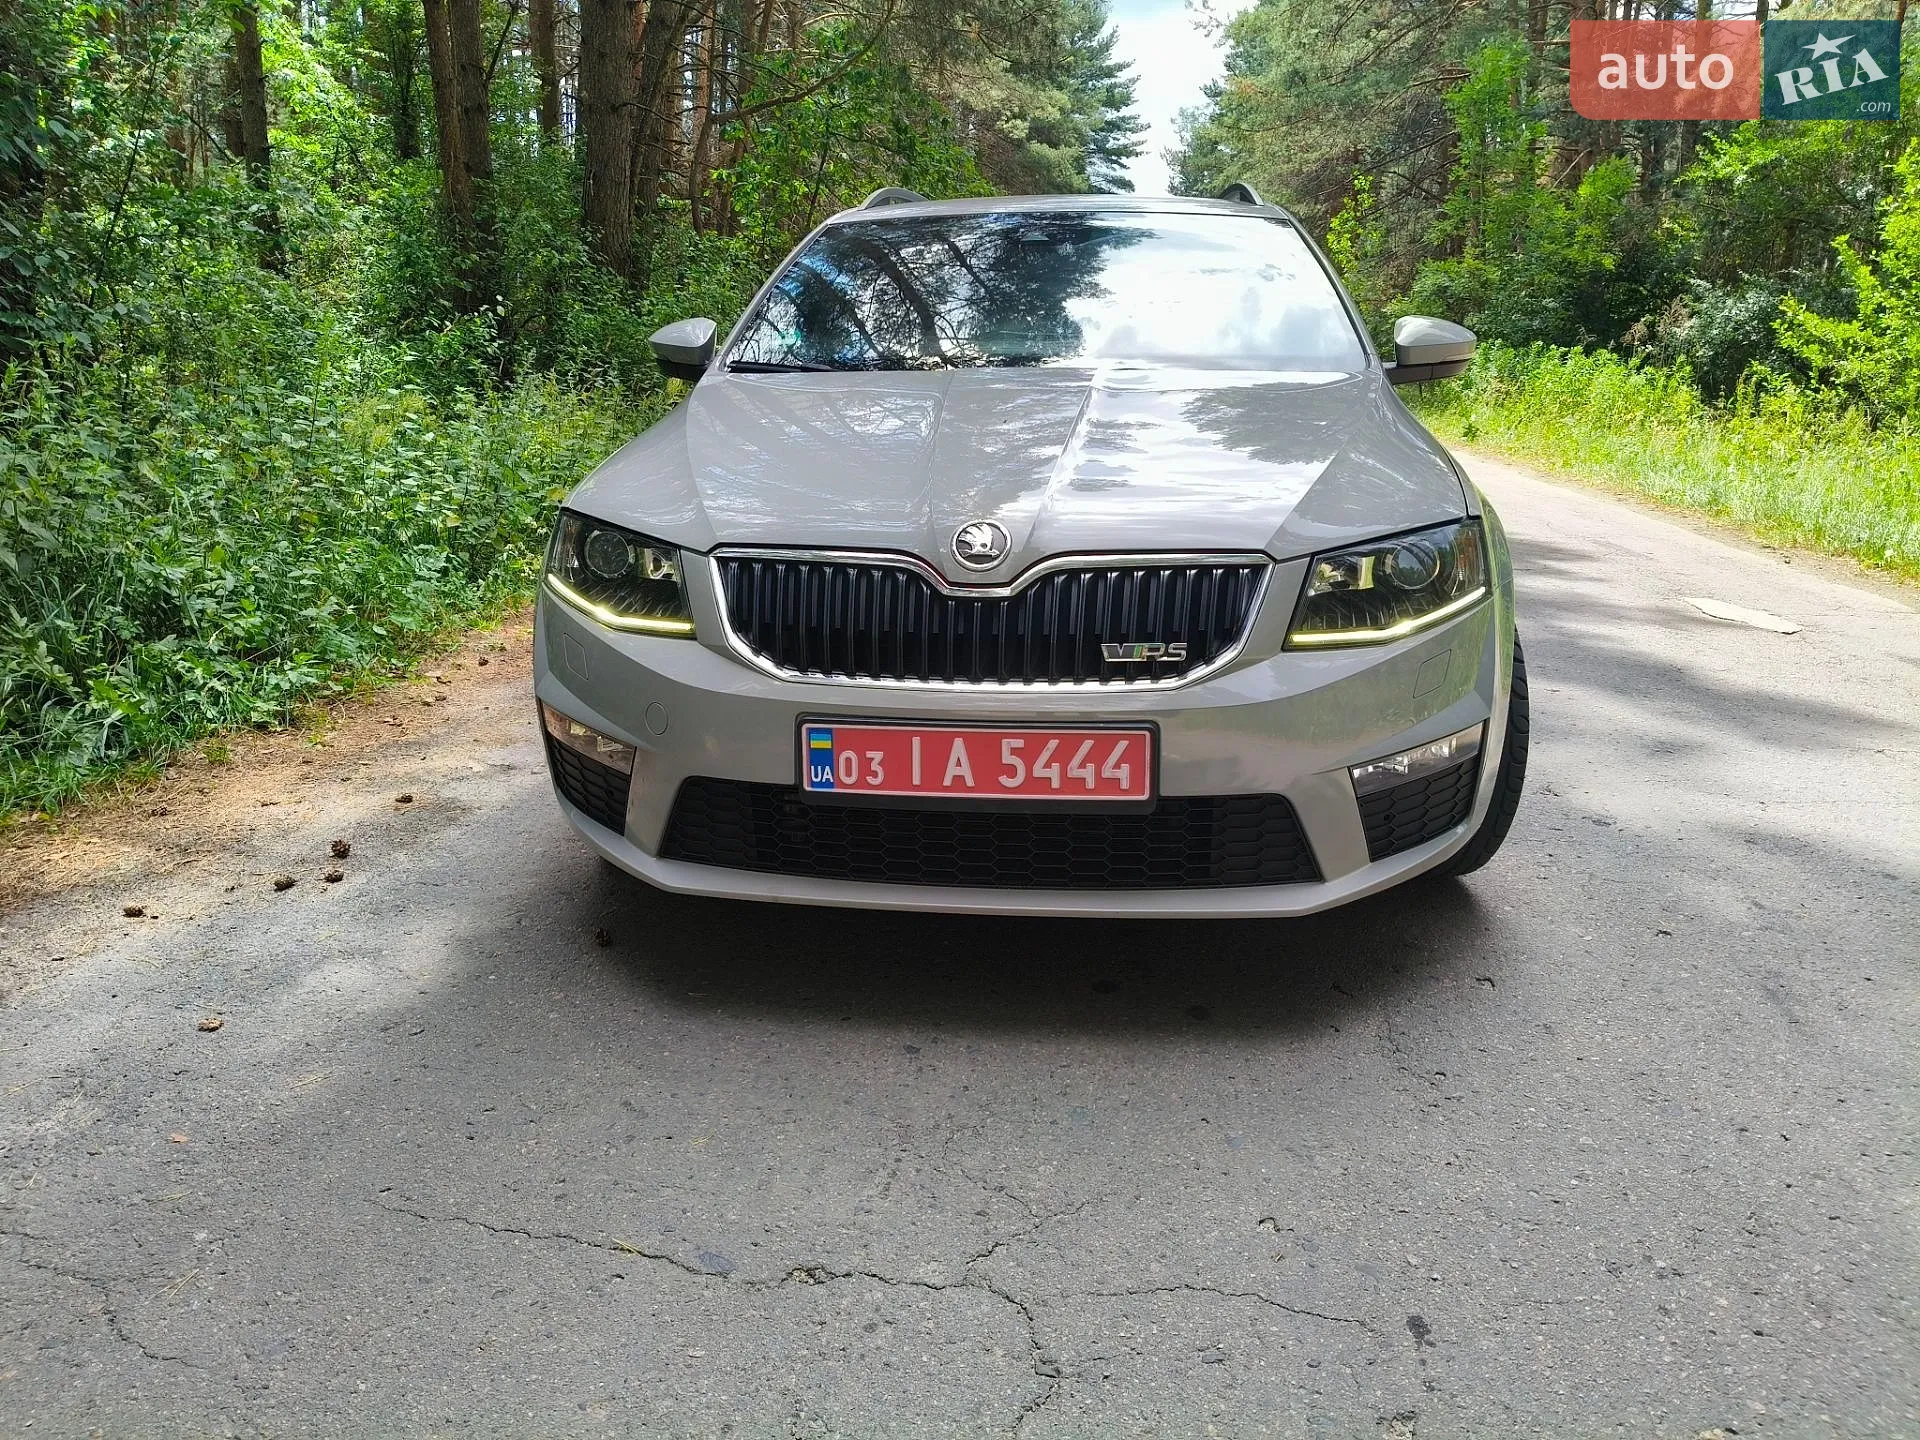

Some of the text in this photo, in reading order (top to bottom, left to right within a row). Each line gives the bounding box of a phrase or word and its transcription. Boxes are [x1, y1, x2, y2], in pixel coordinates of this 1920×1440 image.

[810, 765, 833, 783] UA
[838, 750, 884, 785] 03
[998, 738, 1130, 789] 5444
